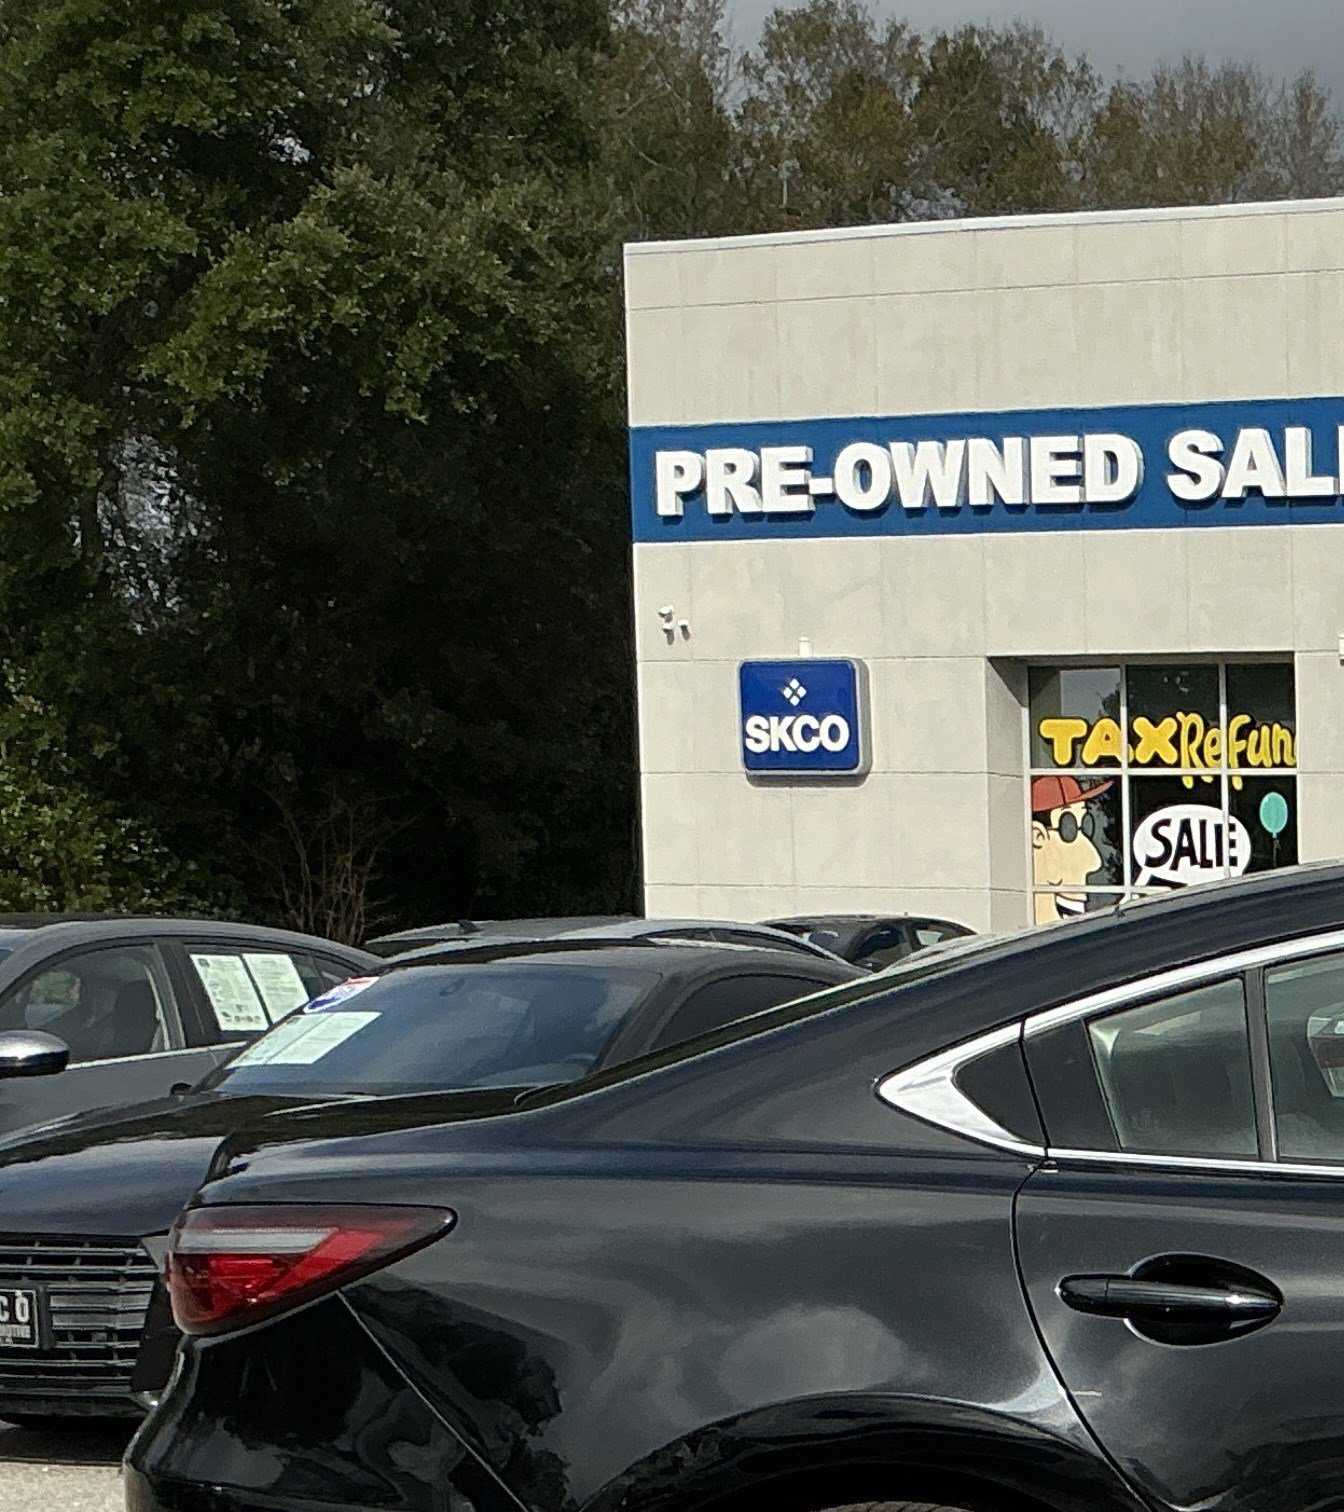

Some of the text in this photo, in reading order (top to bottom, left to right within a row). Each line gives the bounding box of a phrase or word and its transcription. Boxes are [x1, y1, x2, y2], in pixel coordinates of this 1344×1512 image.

[655, 432, 1145, 518] PRE-OWNED
[744, 711, 850, 754] SKCO
[1039, 716, 1179, 765] TAX
[1145, 817, 1239, 871] SALE
